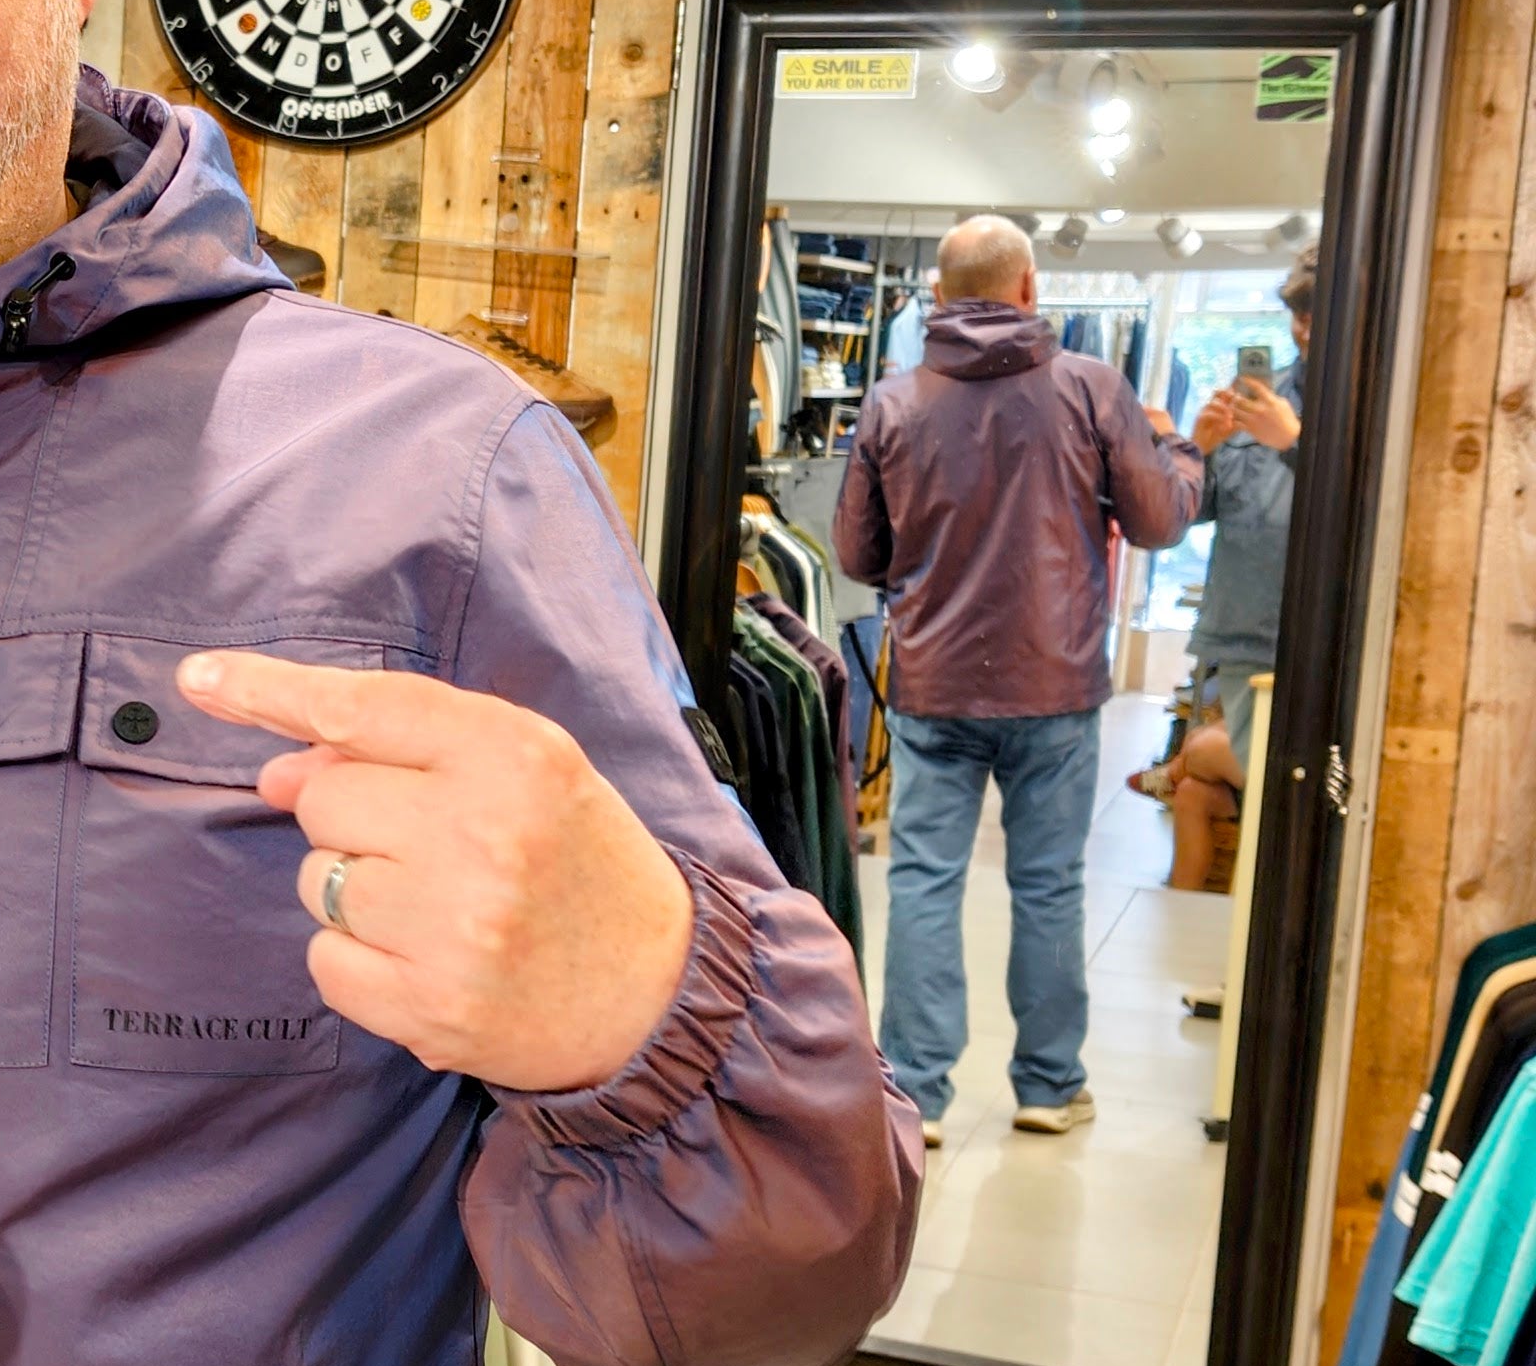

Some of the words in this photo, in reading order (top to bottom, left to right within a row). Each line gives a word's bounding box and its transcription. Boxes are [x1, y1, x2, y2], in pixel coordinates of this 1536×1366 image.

[812, 59, 883, 75] SMILE
[786, 78, 812, 90] YOU
[816, 78, 842, 90] ARE
[846, 78, 864, 90] ON
[869, 78, 908, 90] CCTV!
[280, 90, 392, 122] OFFENDER
[102, 1007, 239, 1042] TERRACE
[246, 1016, 313, 1042] CULT
